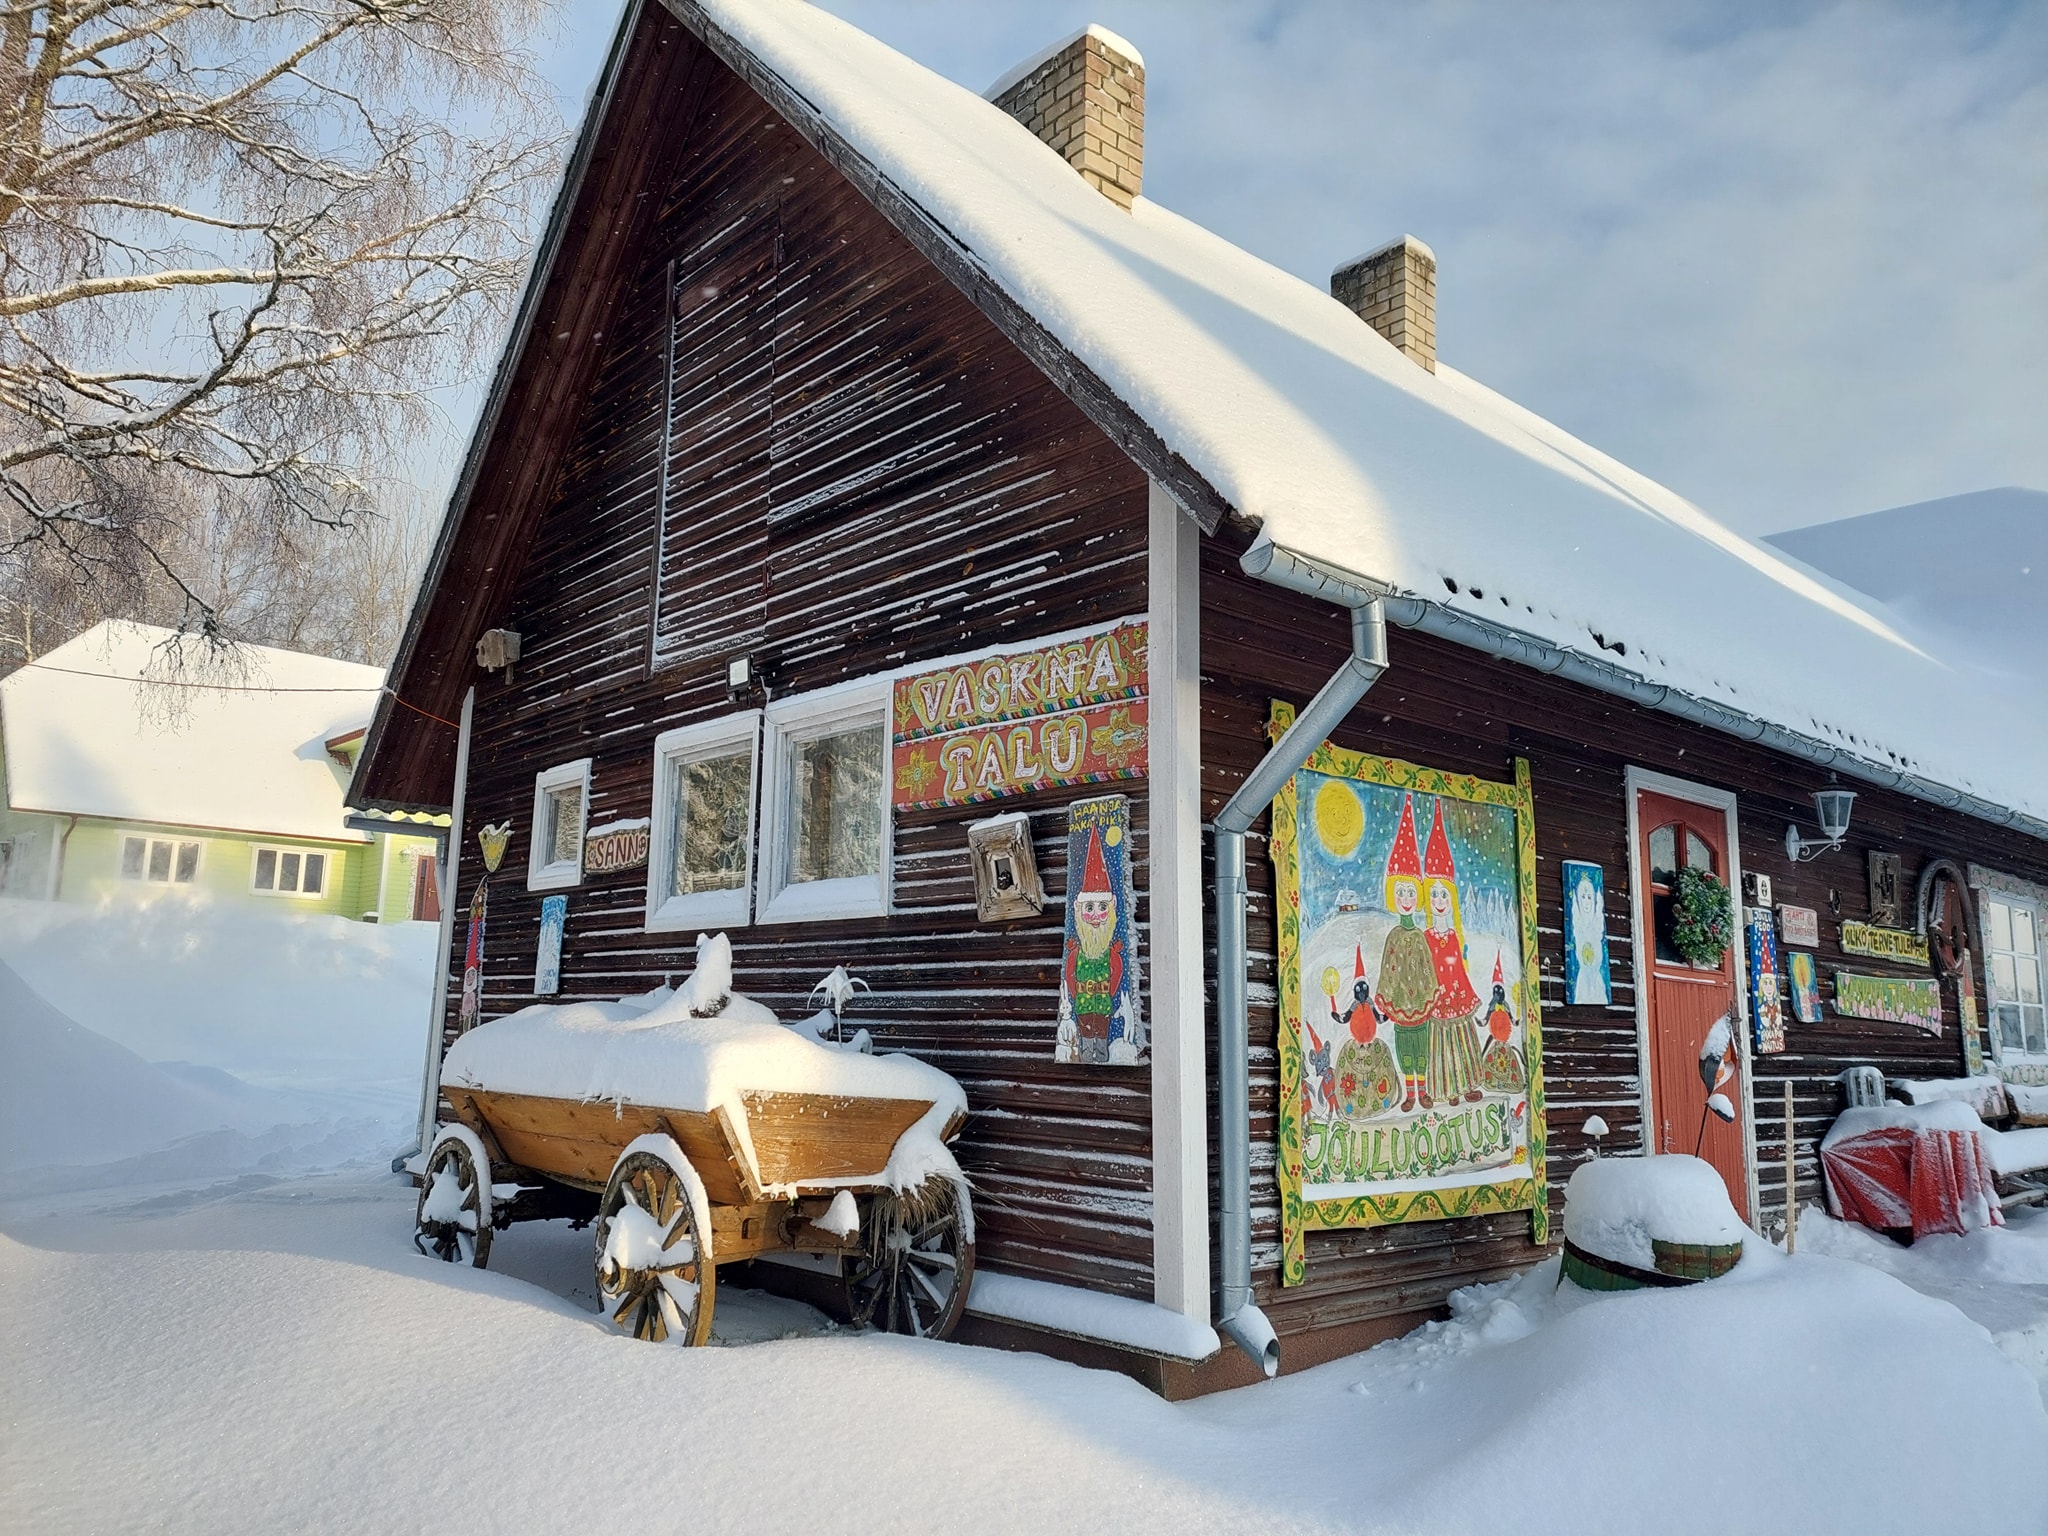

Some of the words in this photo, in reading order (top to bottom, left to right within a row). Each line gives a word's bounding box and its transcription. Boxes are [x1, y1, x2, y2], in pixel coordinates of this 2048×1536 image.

[918, 639, 1122, 724] VASKNA
[946, 725, 1082, 792] TALU
[1073, 800, 1121, 820] HAANJA
[1302, 1102, 1501, 1176] JÕULUOOTUS
